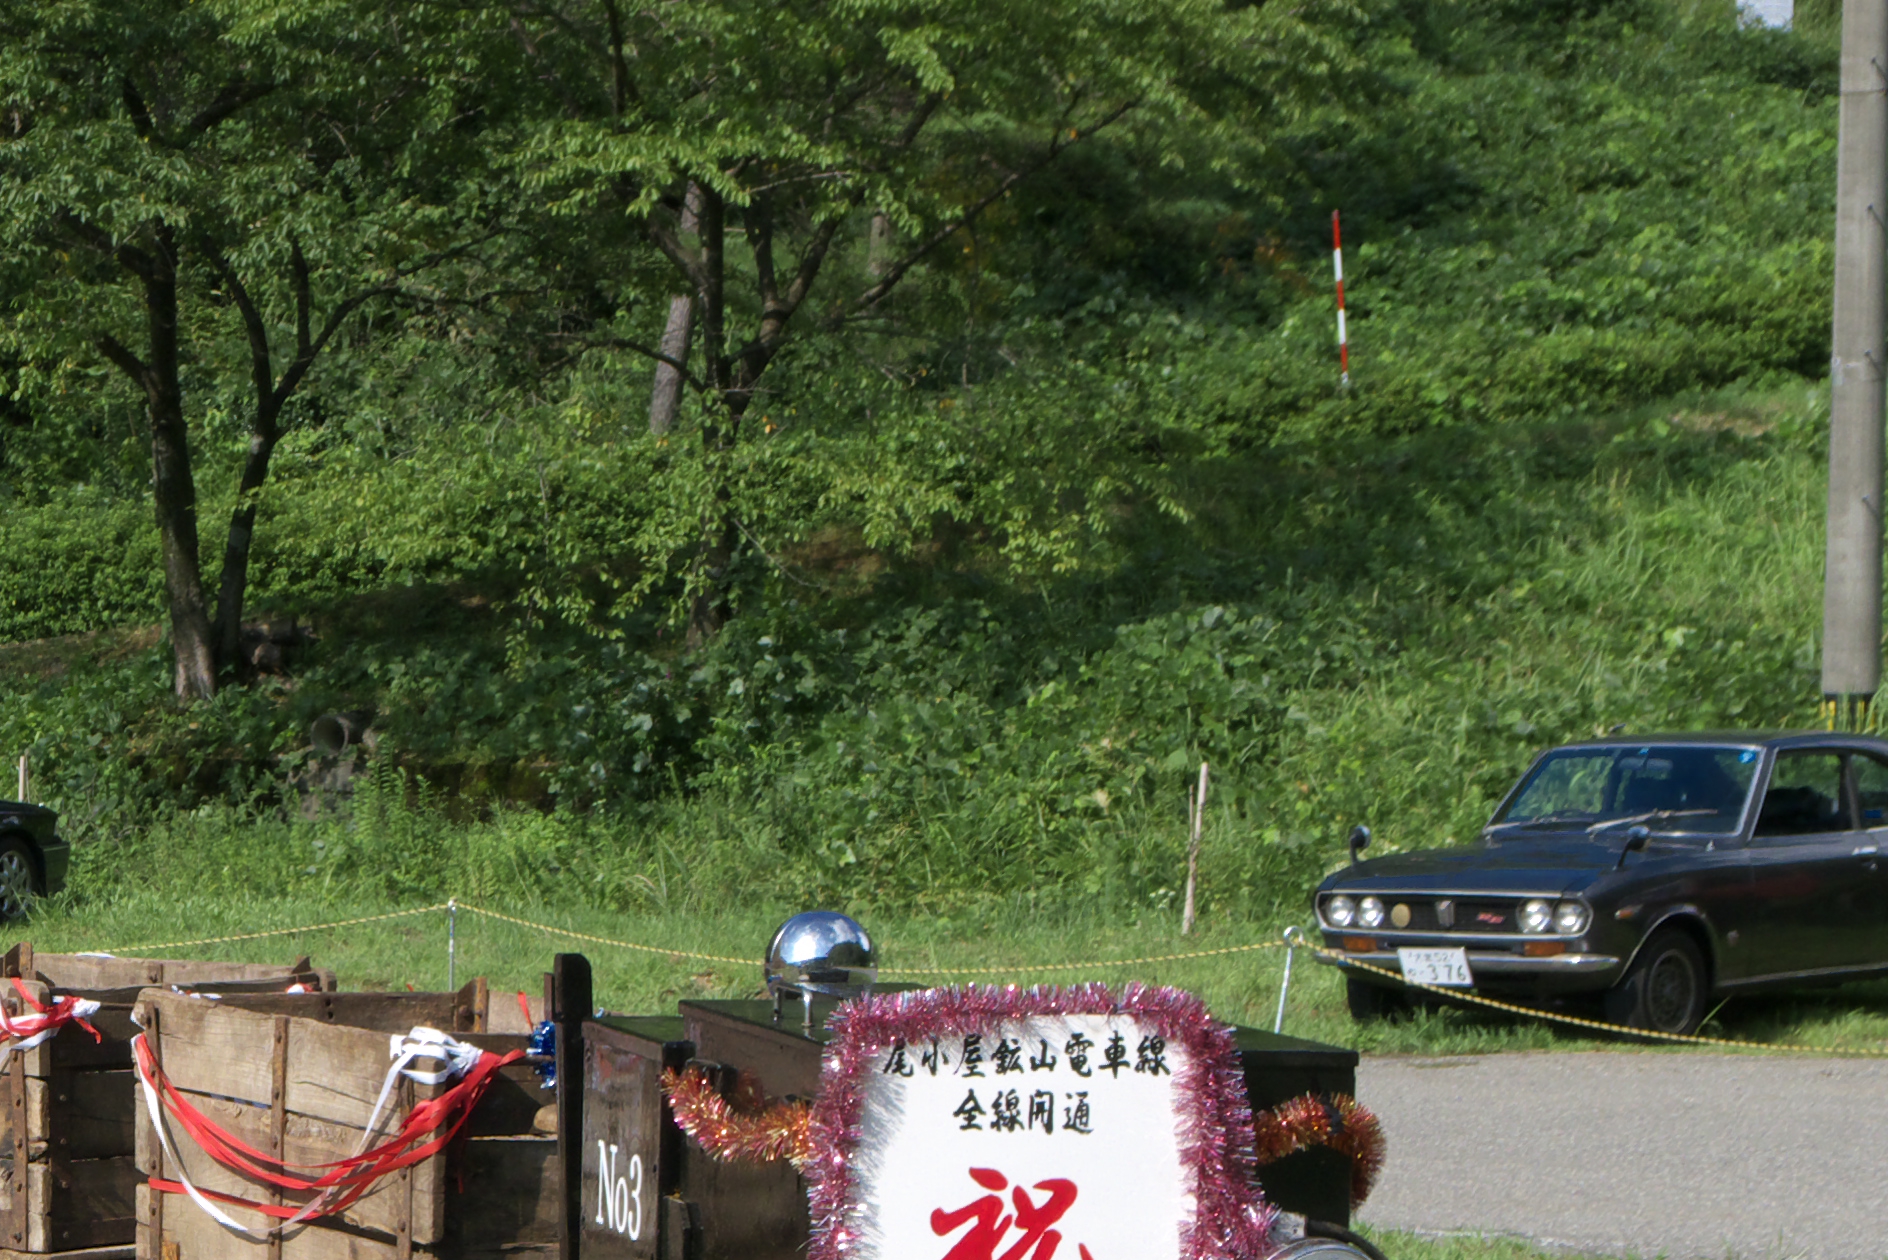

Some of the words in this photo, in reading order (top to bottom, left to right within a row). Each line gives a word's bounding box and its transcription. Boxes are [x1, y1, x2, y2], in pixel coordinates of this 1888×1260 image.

[883, 1030, 1171, 1079] 尾小屋鉱山電車線
[953, 1088, 1094, 1134] 全線開通
[595, 1139, 643, 1241] No3
